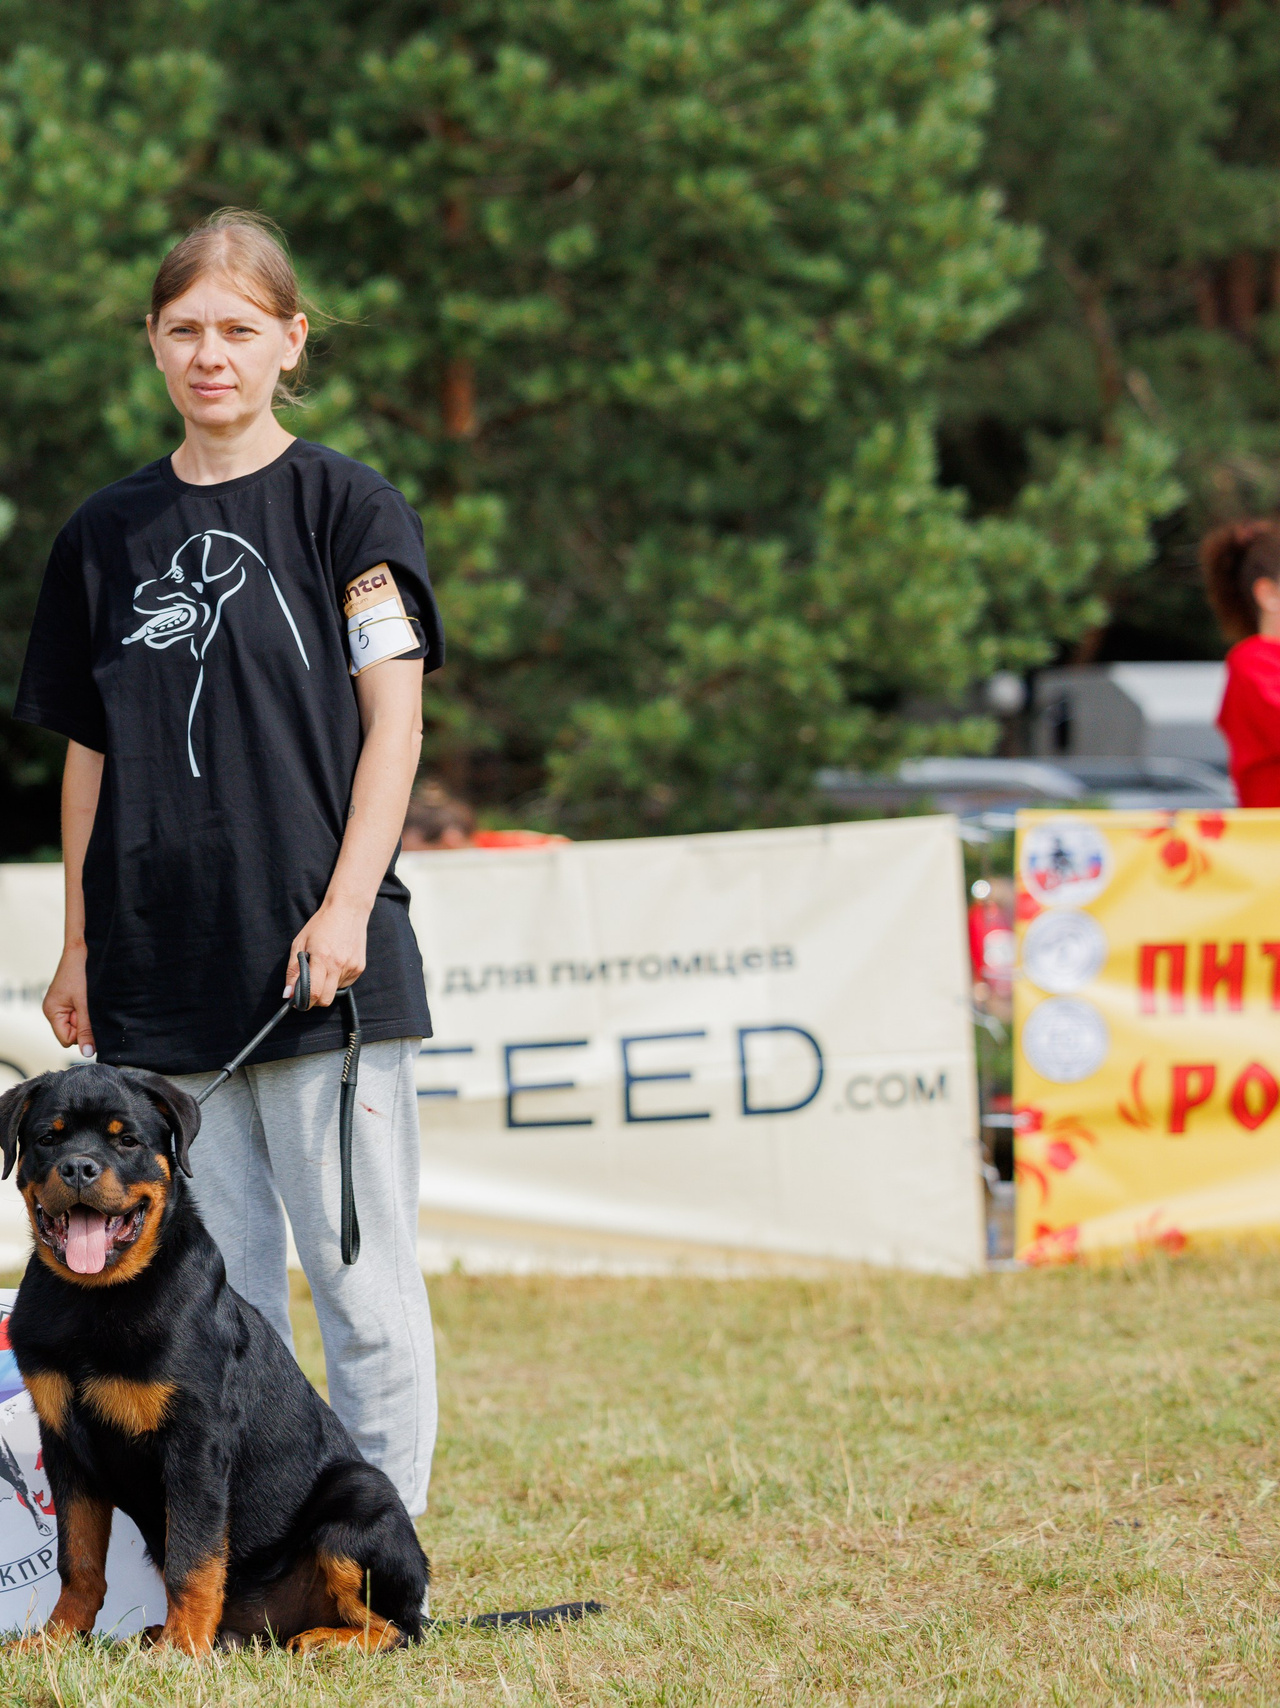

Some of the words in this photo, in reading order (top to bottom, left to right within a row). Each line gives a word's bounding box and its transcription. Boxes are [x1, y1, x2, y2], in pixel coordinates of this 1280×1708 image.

[358, 617, 373, 650] 5
[443, 963, 536, 994] для
[550, 945, 794, 986] питомцев
